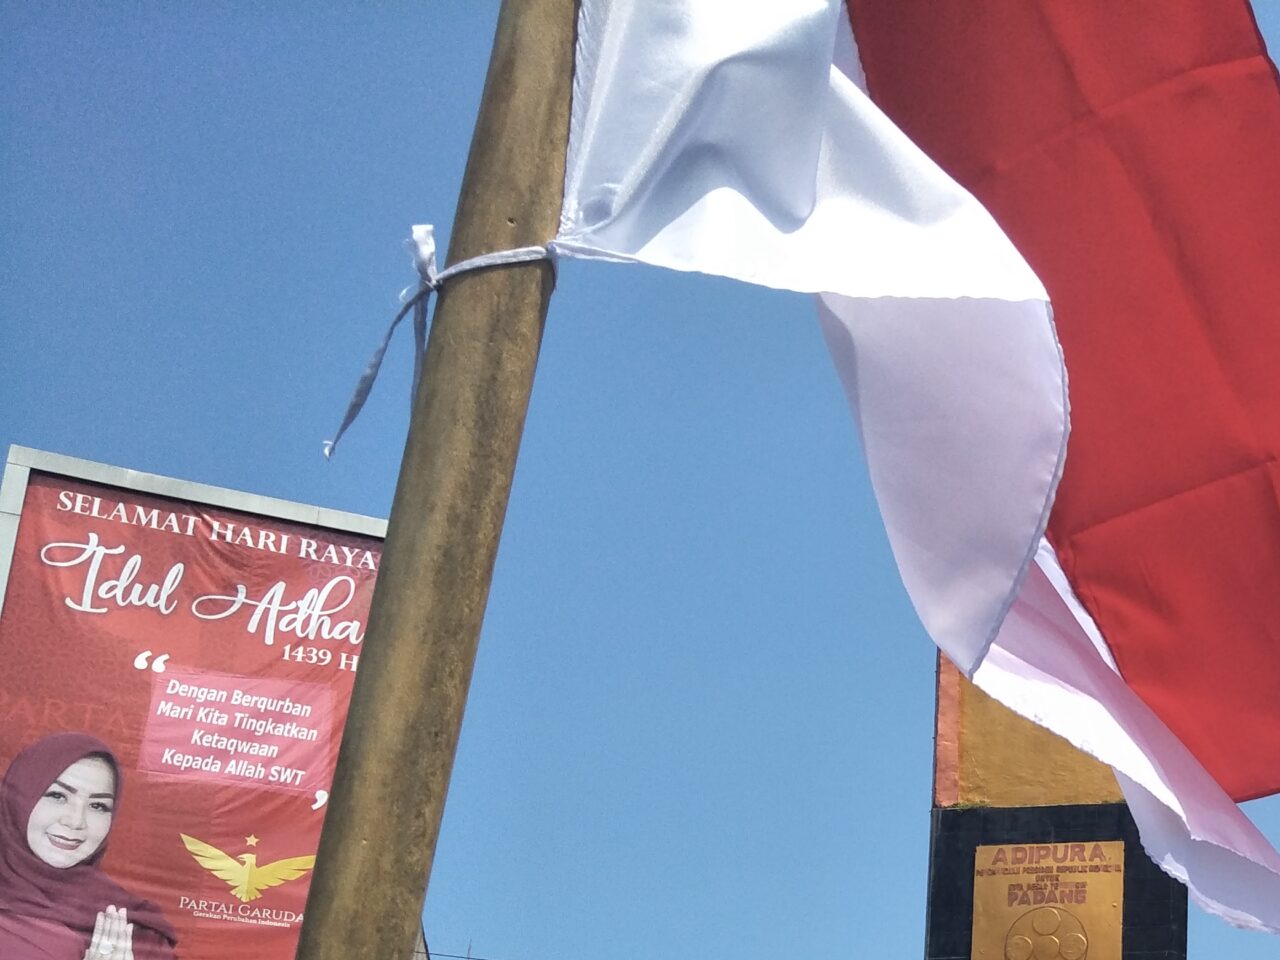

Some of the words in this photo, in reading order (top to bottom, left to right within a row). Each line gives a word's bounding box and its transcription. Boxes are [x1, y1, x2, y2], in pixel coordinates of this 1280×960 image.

[57, 490, 200, 536] SELAMAT
[209, 520, 288, 554] HARI
[298, 537, 376, 571] RAYA
[40, 533, 185, 614] Idul
[191, 575, 364, 645] Adha
[282, 644, 331, 666] 1439
[339, 652, 359, 672] H
[166, 679, 228, 705] Dengan
[230, 690, 312, 719] Berqurban
[156, 701, 192, 720] Mari
[196, 707, 228, 727] Kita
[233, 713, 318, 742] Tingkatkan
[191, 730, 279, 758] Ketaqwaan
[162, 748, 221, 774] Kepada
[224, 759, 265, 779] Allah
[269, 767, 306, 786] SWT
[991, 843, 1107, 865] ADIPURA
[179, 896, 234, 915] PARTAI
[238, 904, 304, 923] GARUDA
[1008, 890, 1088, 907] PADANG
